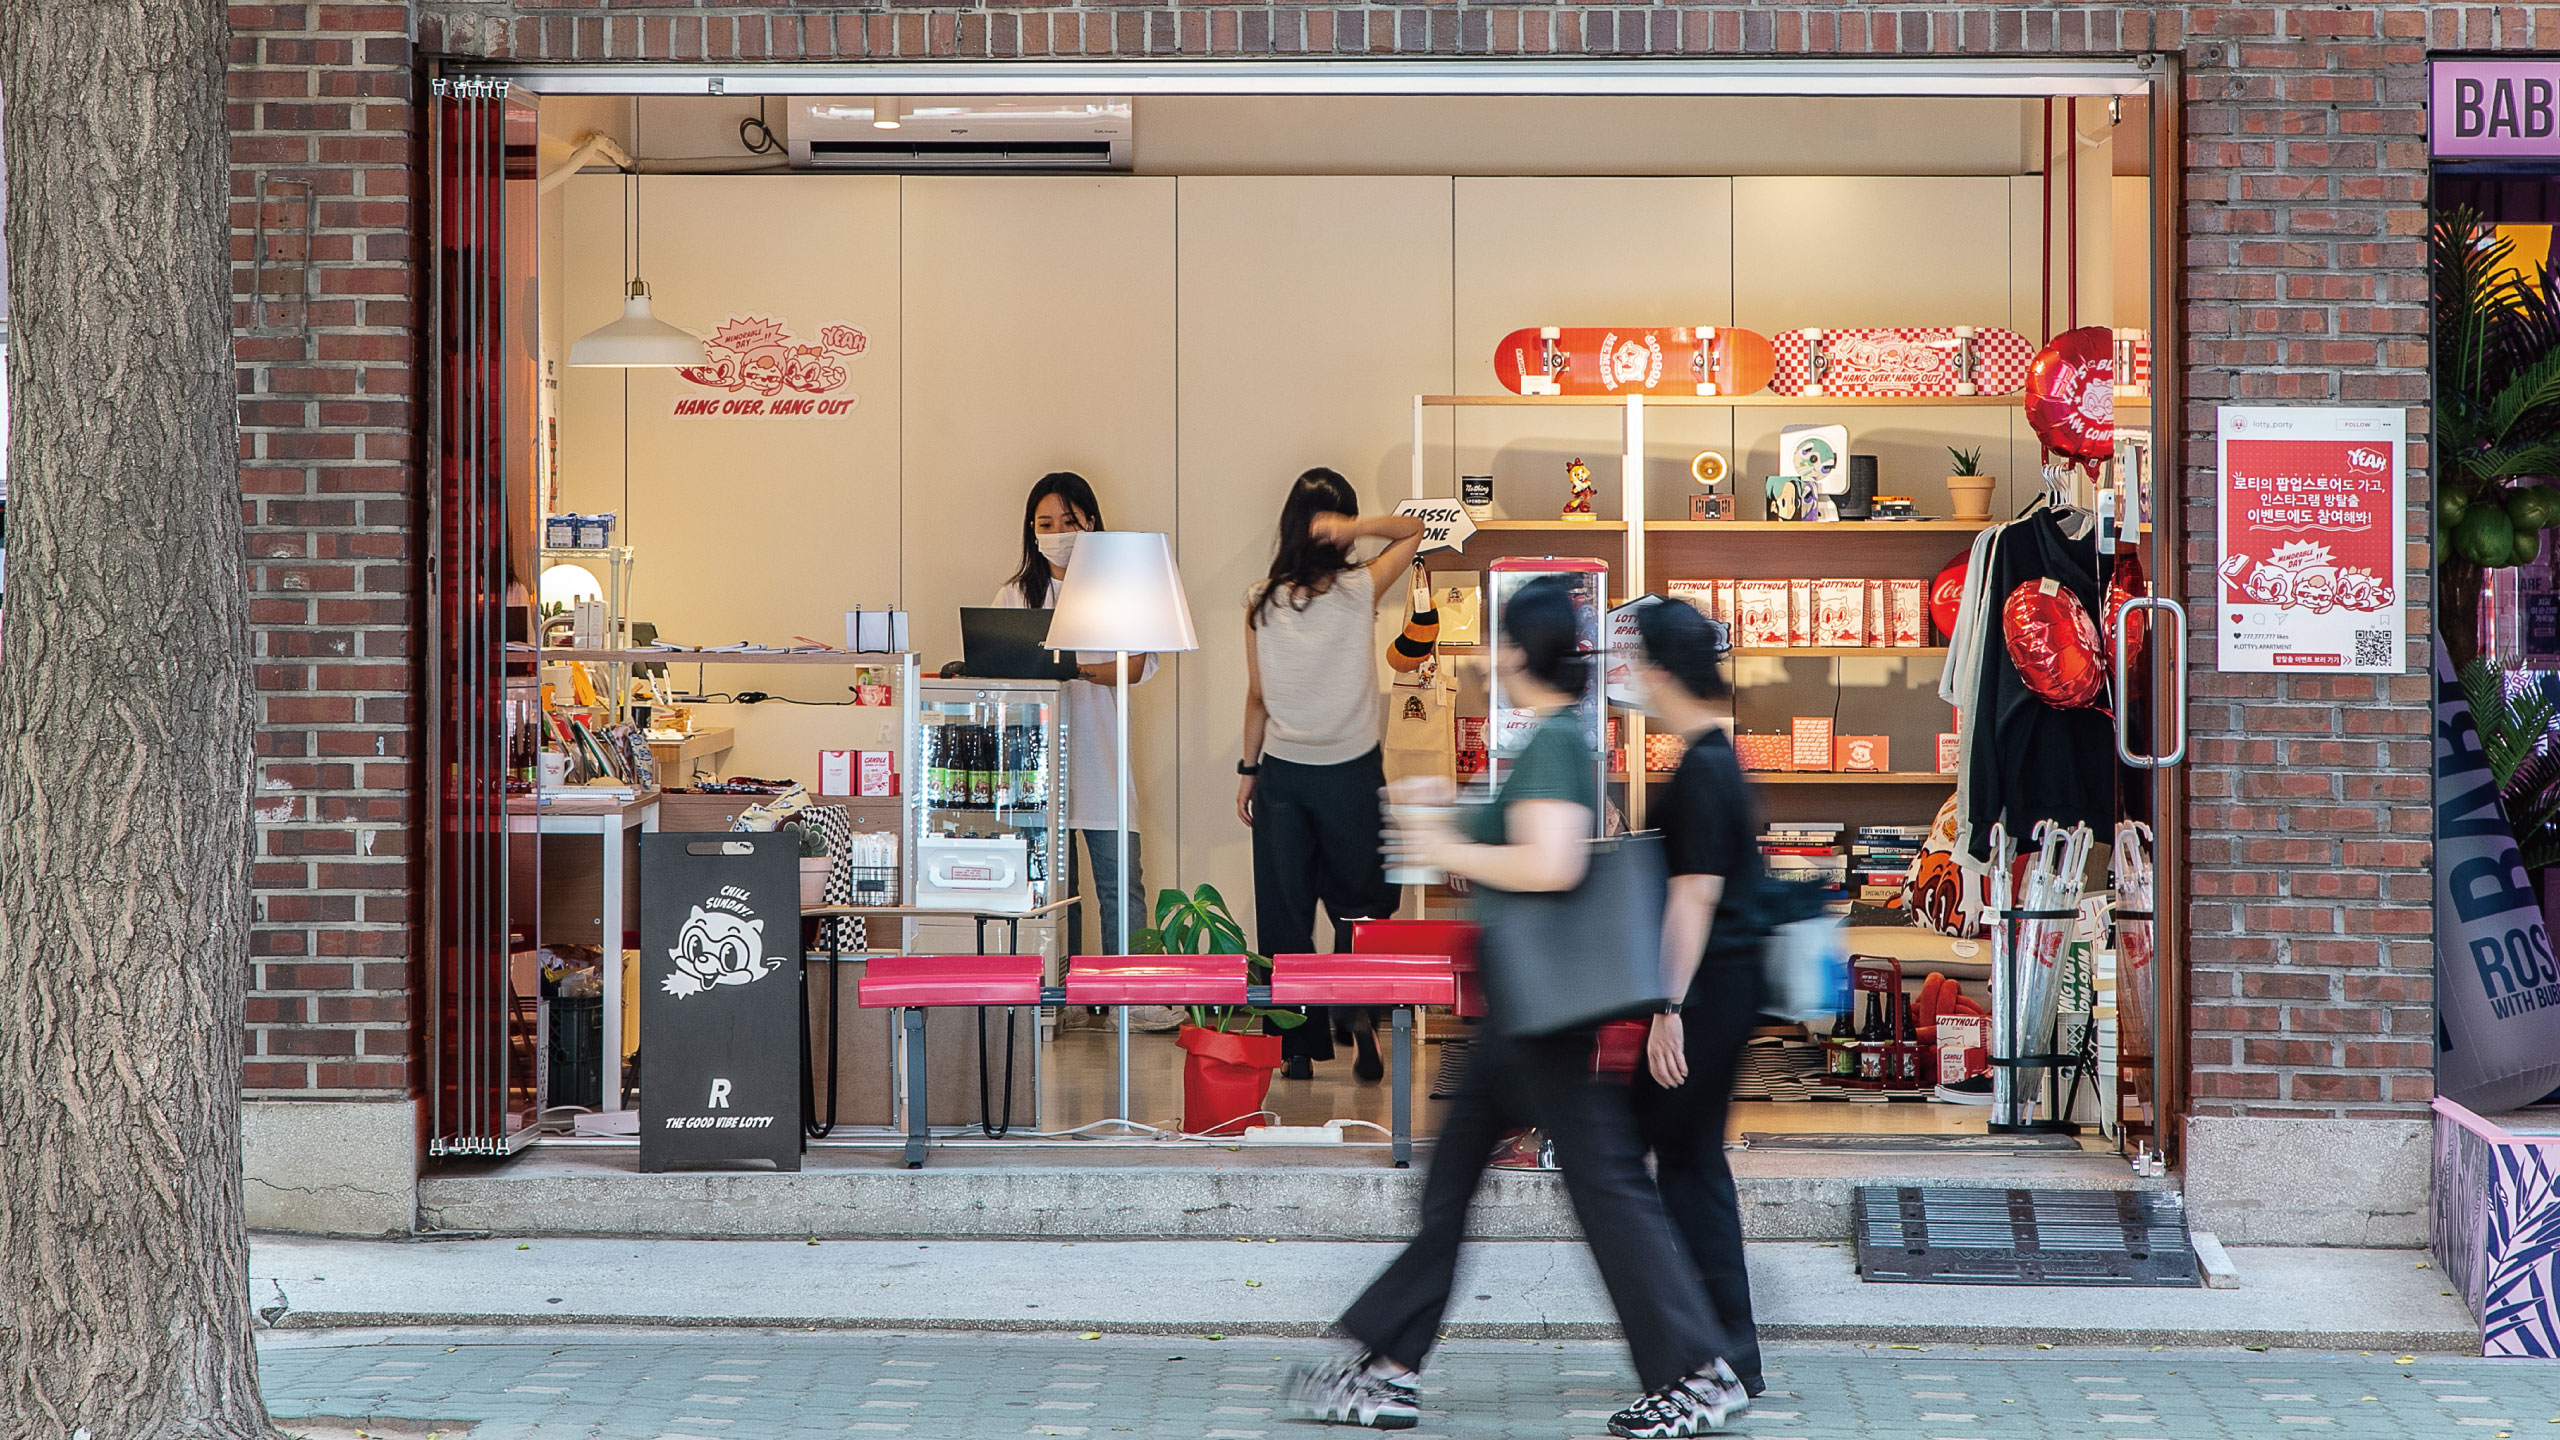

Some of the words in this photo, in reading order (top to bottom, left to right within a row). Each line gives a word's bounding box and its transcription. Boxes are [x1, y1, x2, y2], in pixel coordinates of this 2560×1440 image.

[2456, 78, 2560, 137] BAB
[736, 339, 750, 348] DAY
[821, 326, 866, 352] YEAH
[1600, 332, 1618, 391] MEMORY
[1843, 374, 1866, 382] HANG
[1896, 374, 1918, 382] HANG
[1921, 374, 1940, 382] OUT
[674, 400, 720, 415] HANG
[722, 400, 765, 416] OVER,
[769, 400, 814, 415] HANG
[817, 400, 854, 414] OUT
[2068, 412, 2084, 433] THE
[2253, 420, 2293, 430] lotty_party
[2348, 448, 2386, 471] YEAH
[2234, 478, 2272, 491] 로티의
[2276, 477, 2354, 492] 팝업스토어도
[2358, 480, 2385, 493] 가고,
[2260, 494, 2320, 507] 인스타그램
[2324, 494, 2360, 508] 방탈출
[2248, 508, 2314, 524] 이벤트에도
[2317, 510, 2372, 524] 참여해봐!
[2288, 558, 2303, 568] DAY
[1668, 582, 1710, 590] LOTTYNOLA
[1742, 582, 1787, 590] LOTTYNOLA
[2294, 656, 2312, 664] 이벤트
[720, 885, 751, 901] CHILL
[706, 897, 754, 917] SUNDAY!
[2469, 924, 2558, 999] ROS
[2078, 948, 2092, 1013] PM-9AM
[2491, 990, 2536, 1020] WITH
[1937, 1018, 1980, 1026] LOTTYNOLA
[708, 1078, 732, 1108] R
[666, 1117, 686, 1128] THE
[686, 1116, 714, 1128] GOOD
[716, 1116, 740, 1128] VIBE
[738, 1116, 774, 1128] LOTTY
